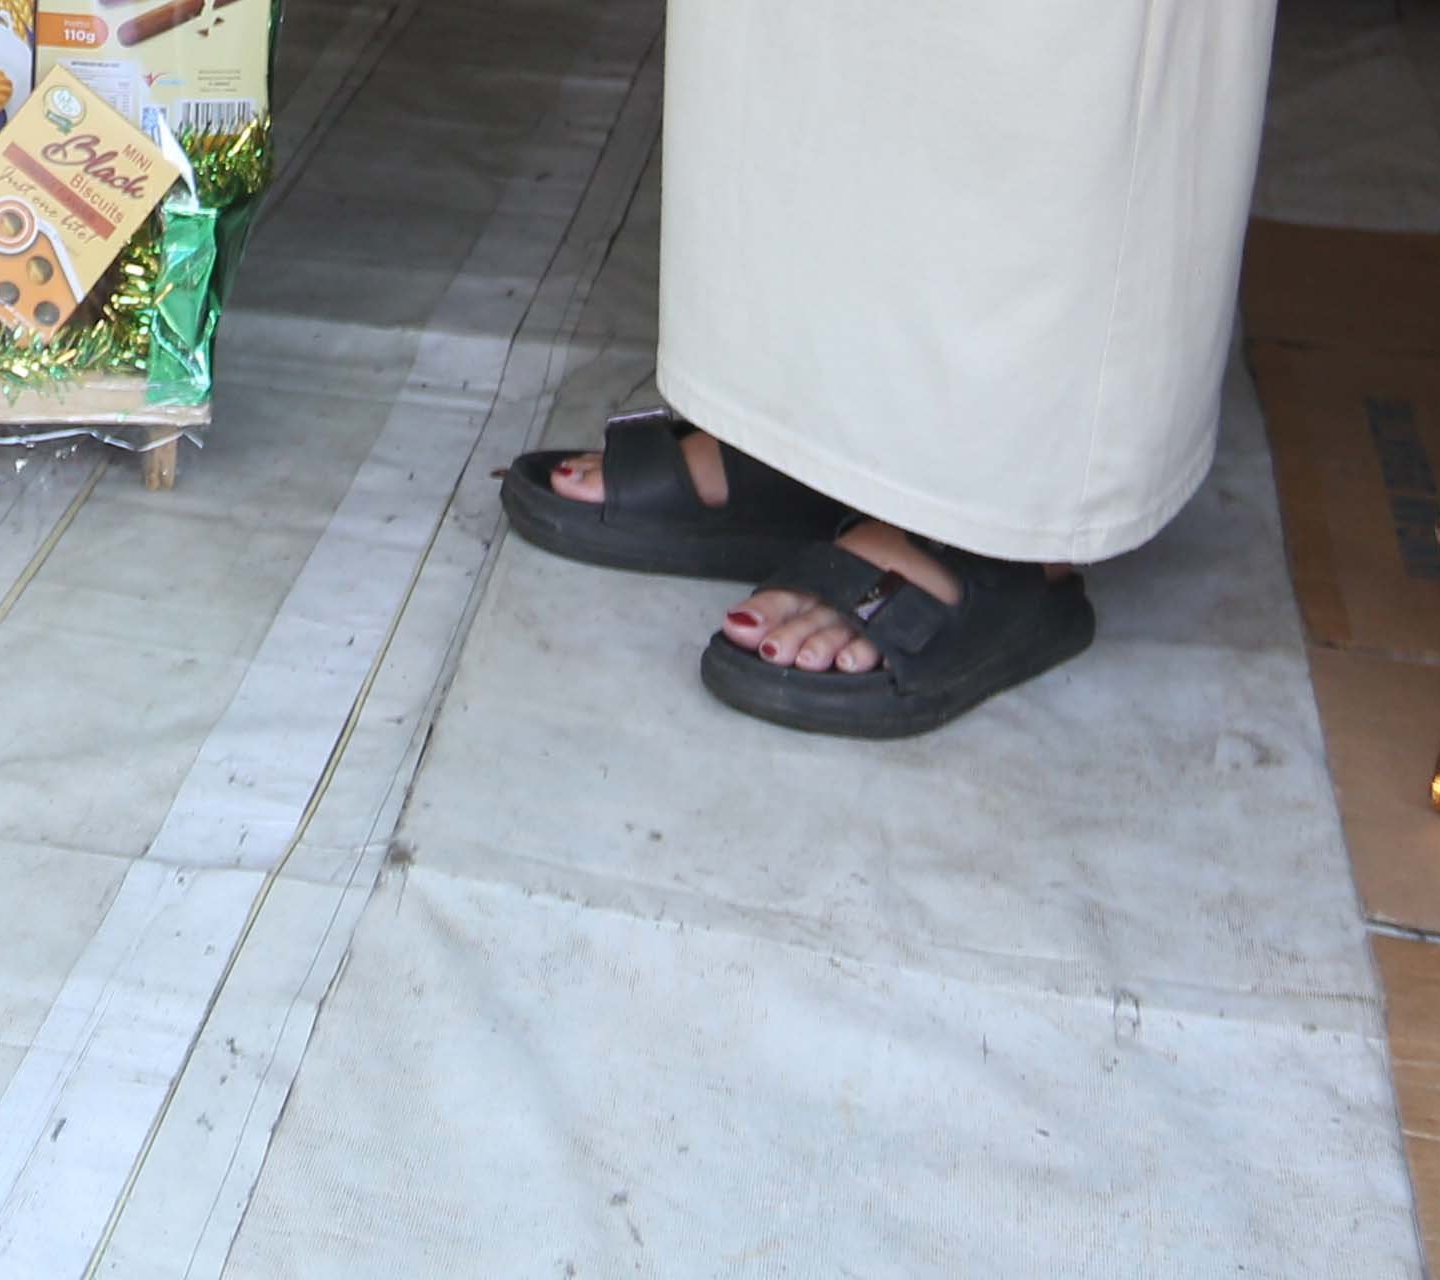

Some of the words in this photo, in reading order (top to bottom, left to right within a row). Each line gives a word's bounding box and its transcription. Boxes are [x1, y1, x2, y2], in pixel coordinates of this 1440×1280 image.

[61, 28, 98, 46] 110g
[42, 134, 149, 204] Black
[121, 143, 153, 173] MINI
[69, 172, 124, 224] Biscuits
